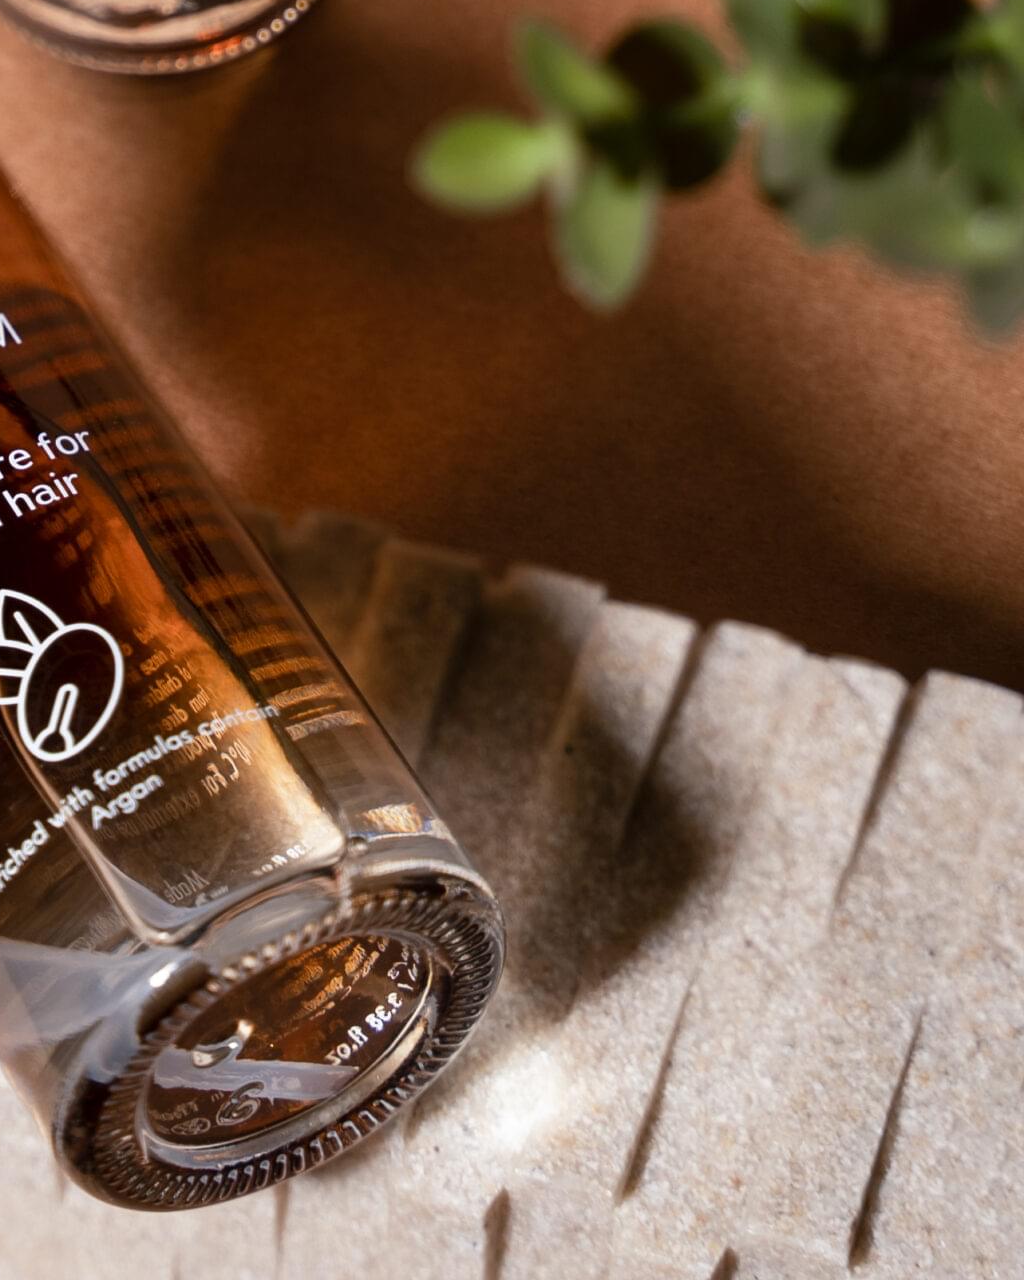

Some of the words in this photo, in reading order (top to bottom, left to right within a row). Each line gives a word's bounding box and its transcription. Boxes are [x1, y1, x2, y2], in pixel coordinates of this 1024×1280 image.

[36, 429, 90, 466] for
[12, 469, 81, 518] hair
[48, 786, 94, 829] with
[93, 733, 193, 793] formulas
[196, 703, 281, 738] contain
[90, 773, 164, 830] Argan
